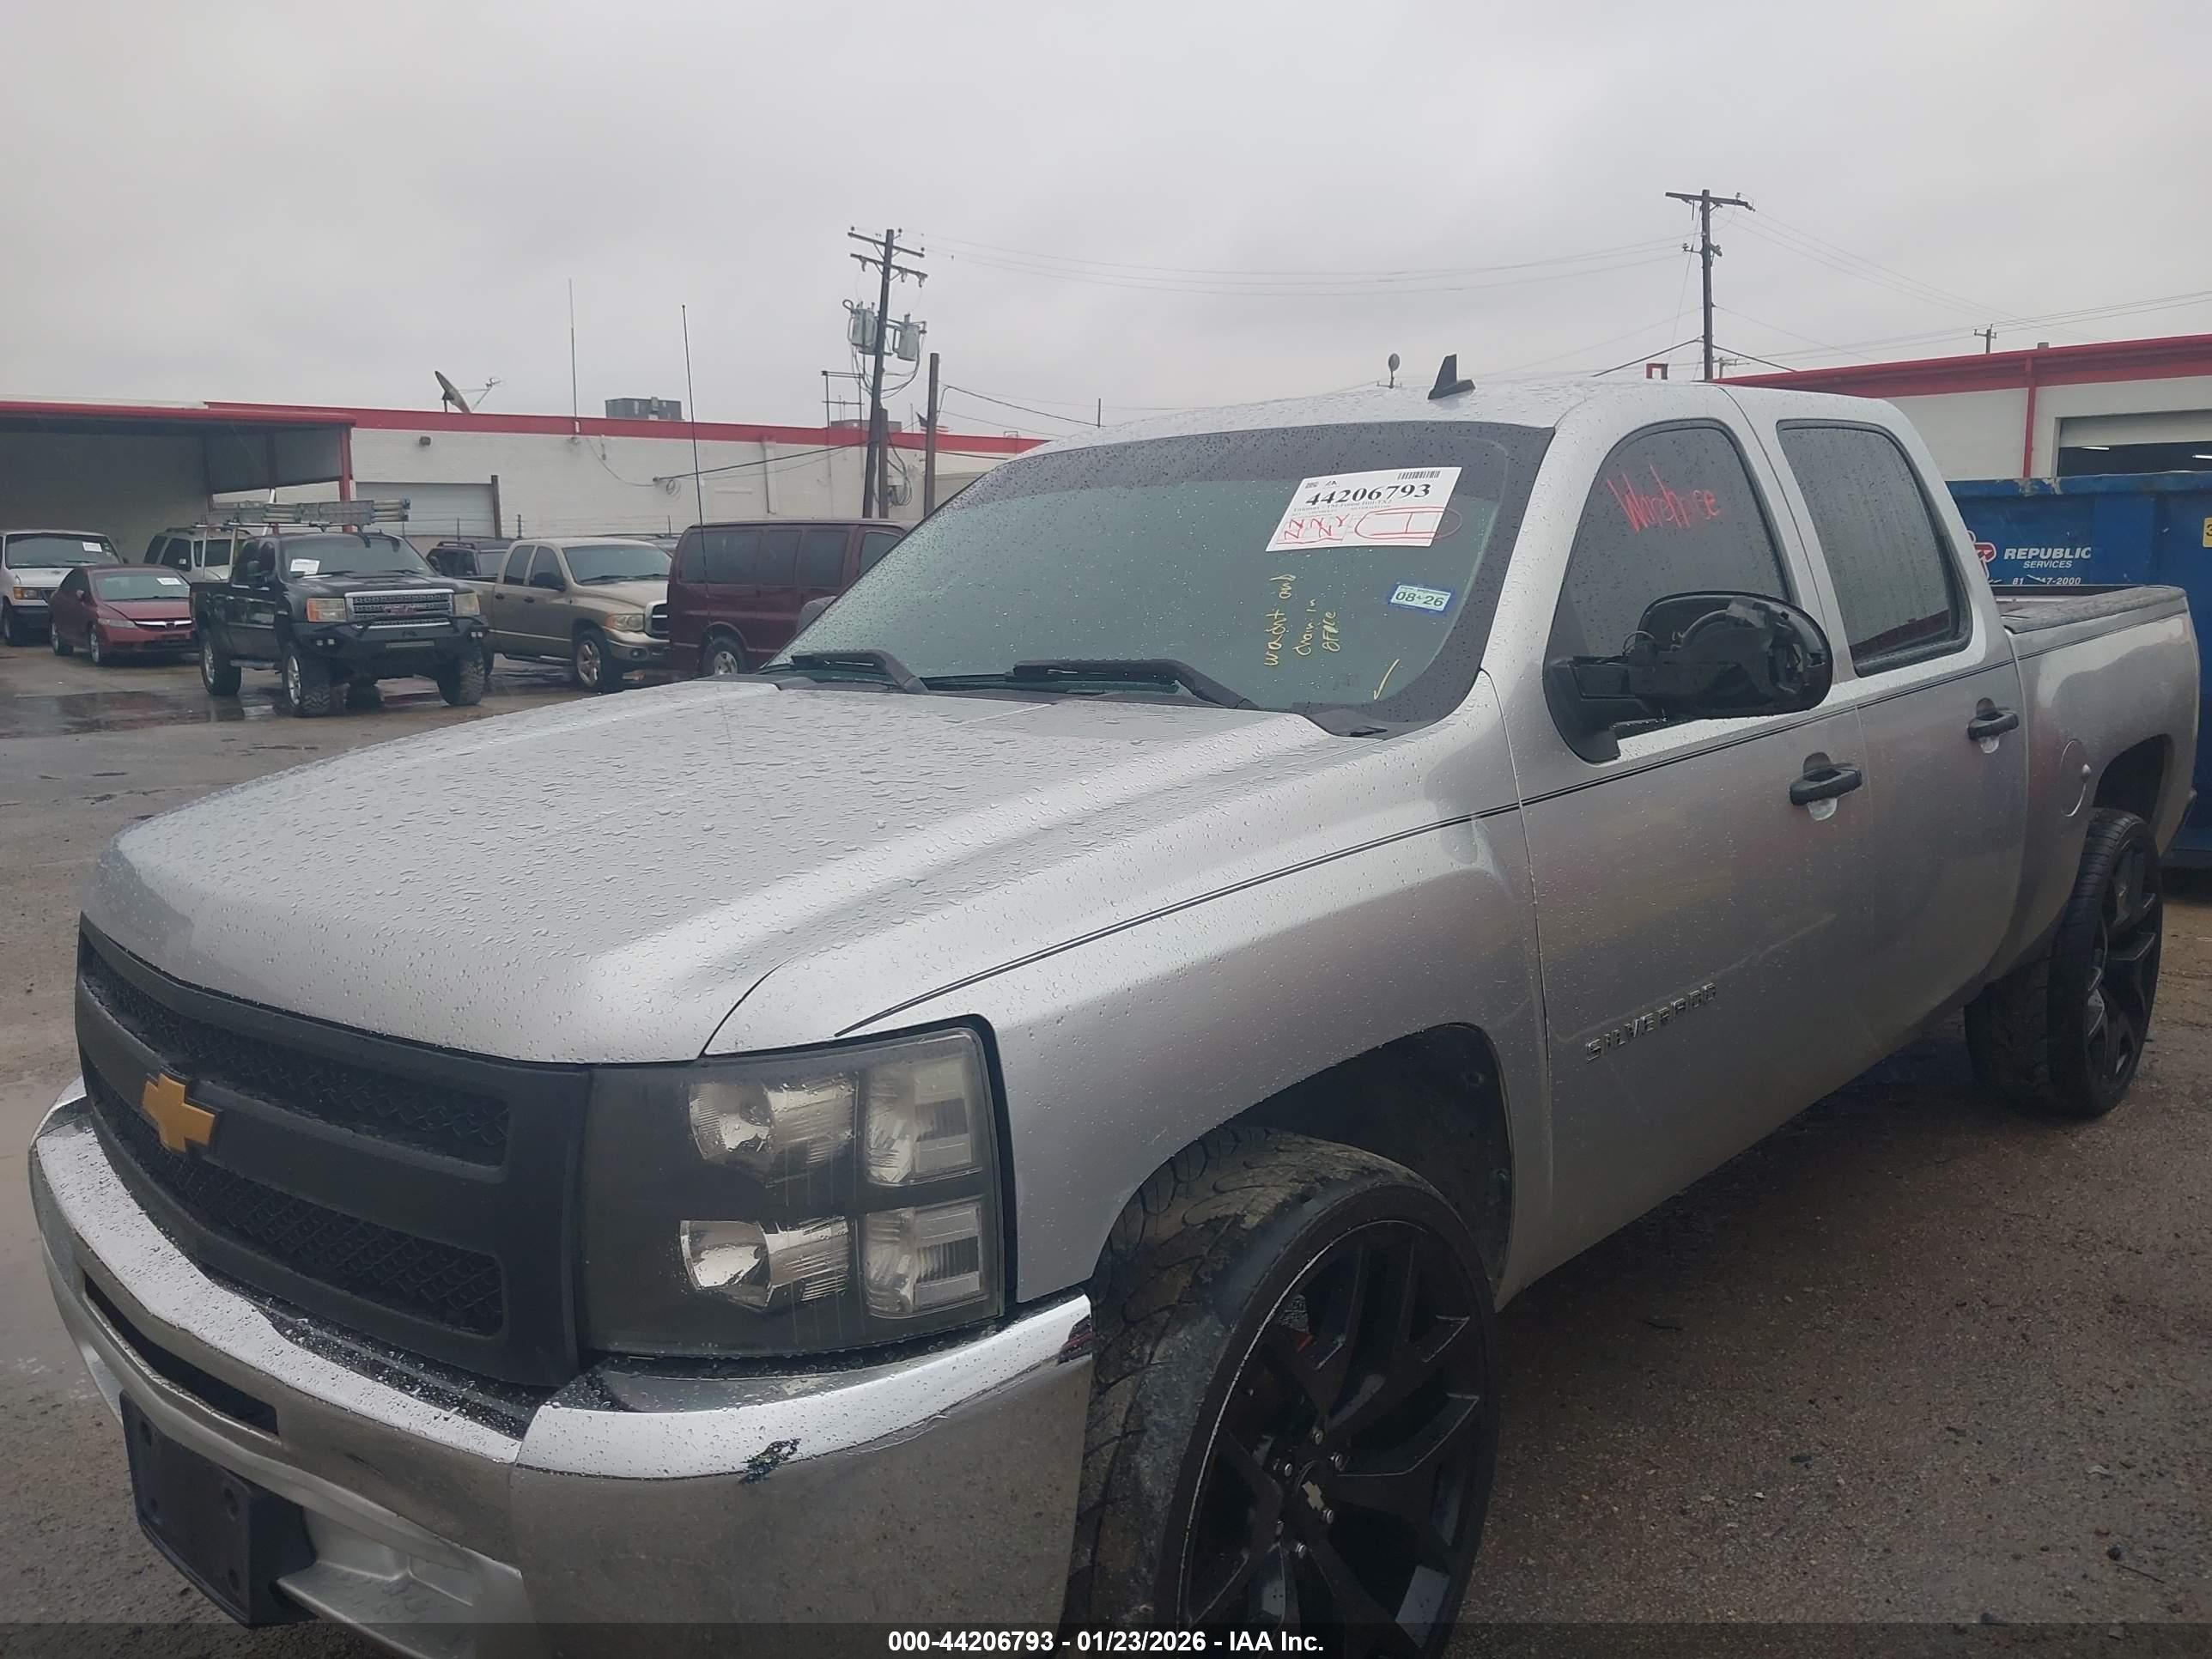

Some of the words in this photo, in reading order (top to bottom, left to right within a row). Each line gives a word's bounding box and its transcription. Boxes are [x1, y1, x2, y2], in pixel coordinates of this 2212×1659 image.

[1305, 483, 1431, 506] 44206793
[2004, 547, 2092, 560] REPUBLIC
[2023, 560, 2073, 568] SERVICES
